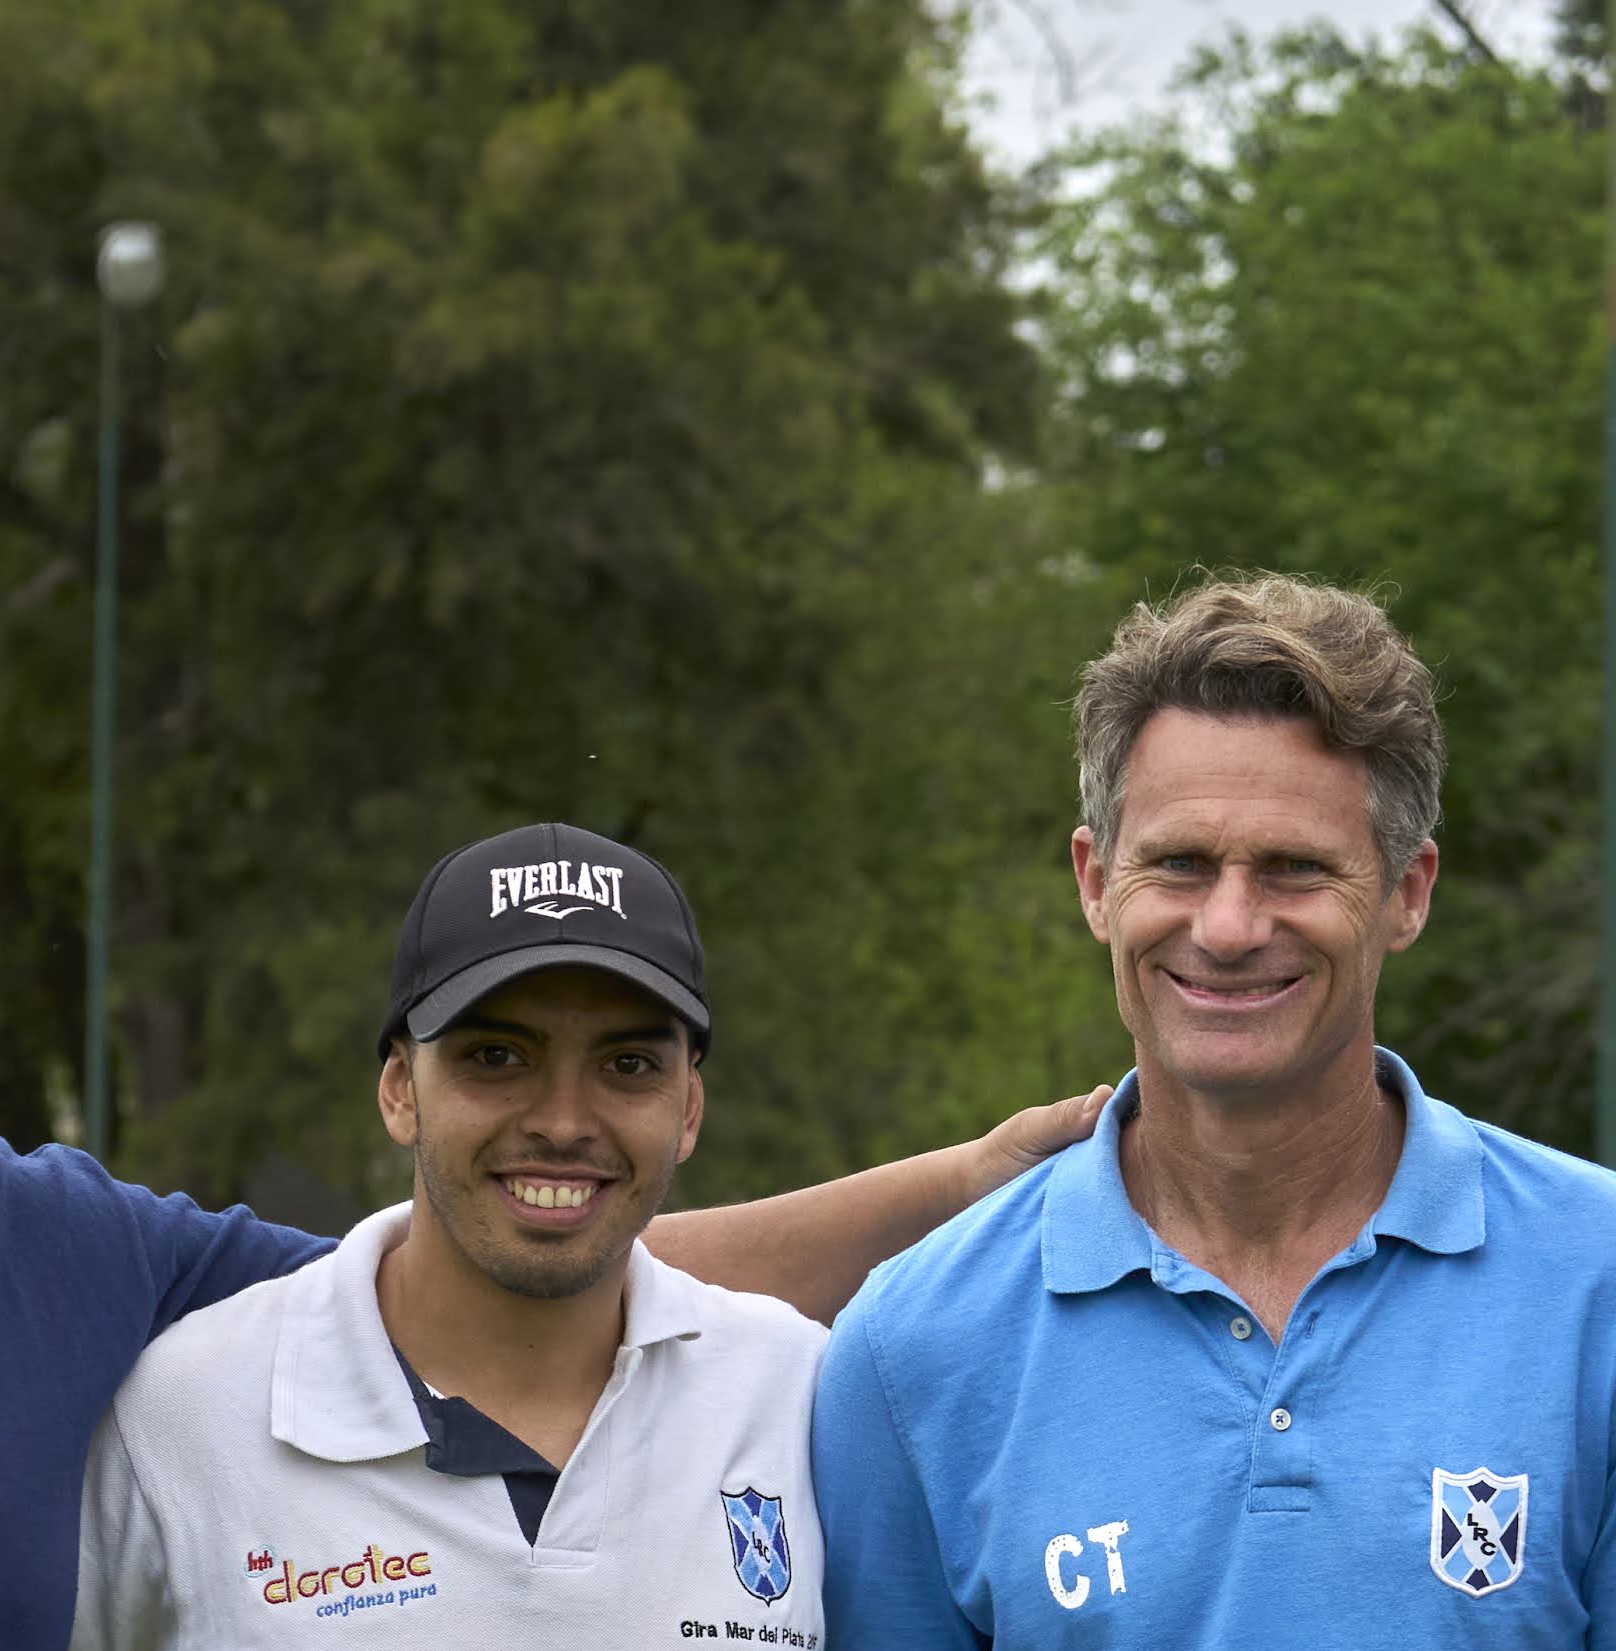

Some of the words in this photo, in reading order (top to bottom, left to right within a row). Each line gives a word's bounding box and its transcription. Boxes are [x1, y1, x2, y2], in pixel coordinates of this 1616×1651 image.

[489, 861, 623, 920] EVERLAST
[1467, 1512, 1497, 1556] LRC
[1044, 1519, 1129, 1609] CT
[316, 1590, 394, 1618] confianza
[399, 1584, 437, 1606] pura
[680, 1620, 718, 1638] Gira
[725, 1621, 755, 1641] Mar
[759, 1625, 778, 1644] del
[782, 1628, 804, 1648] Plata
